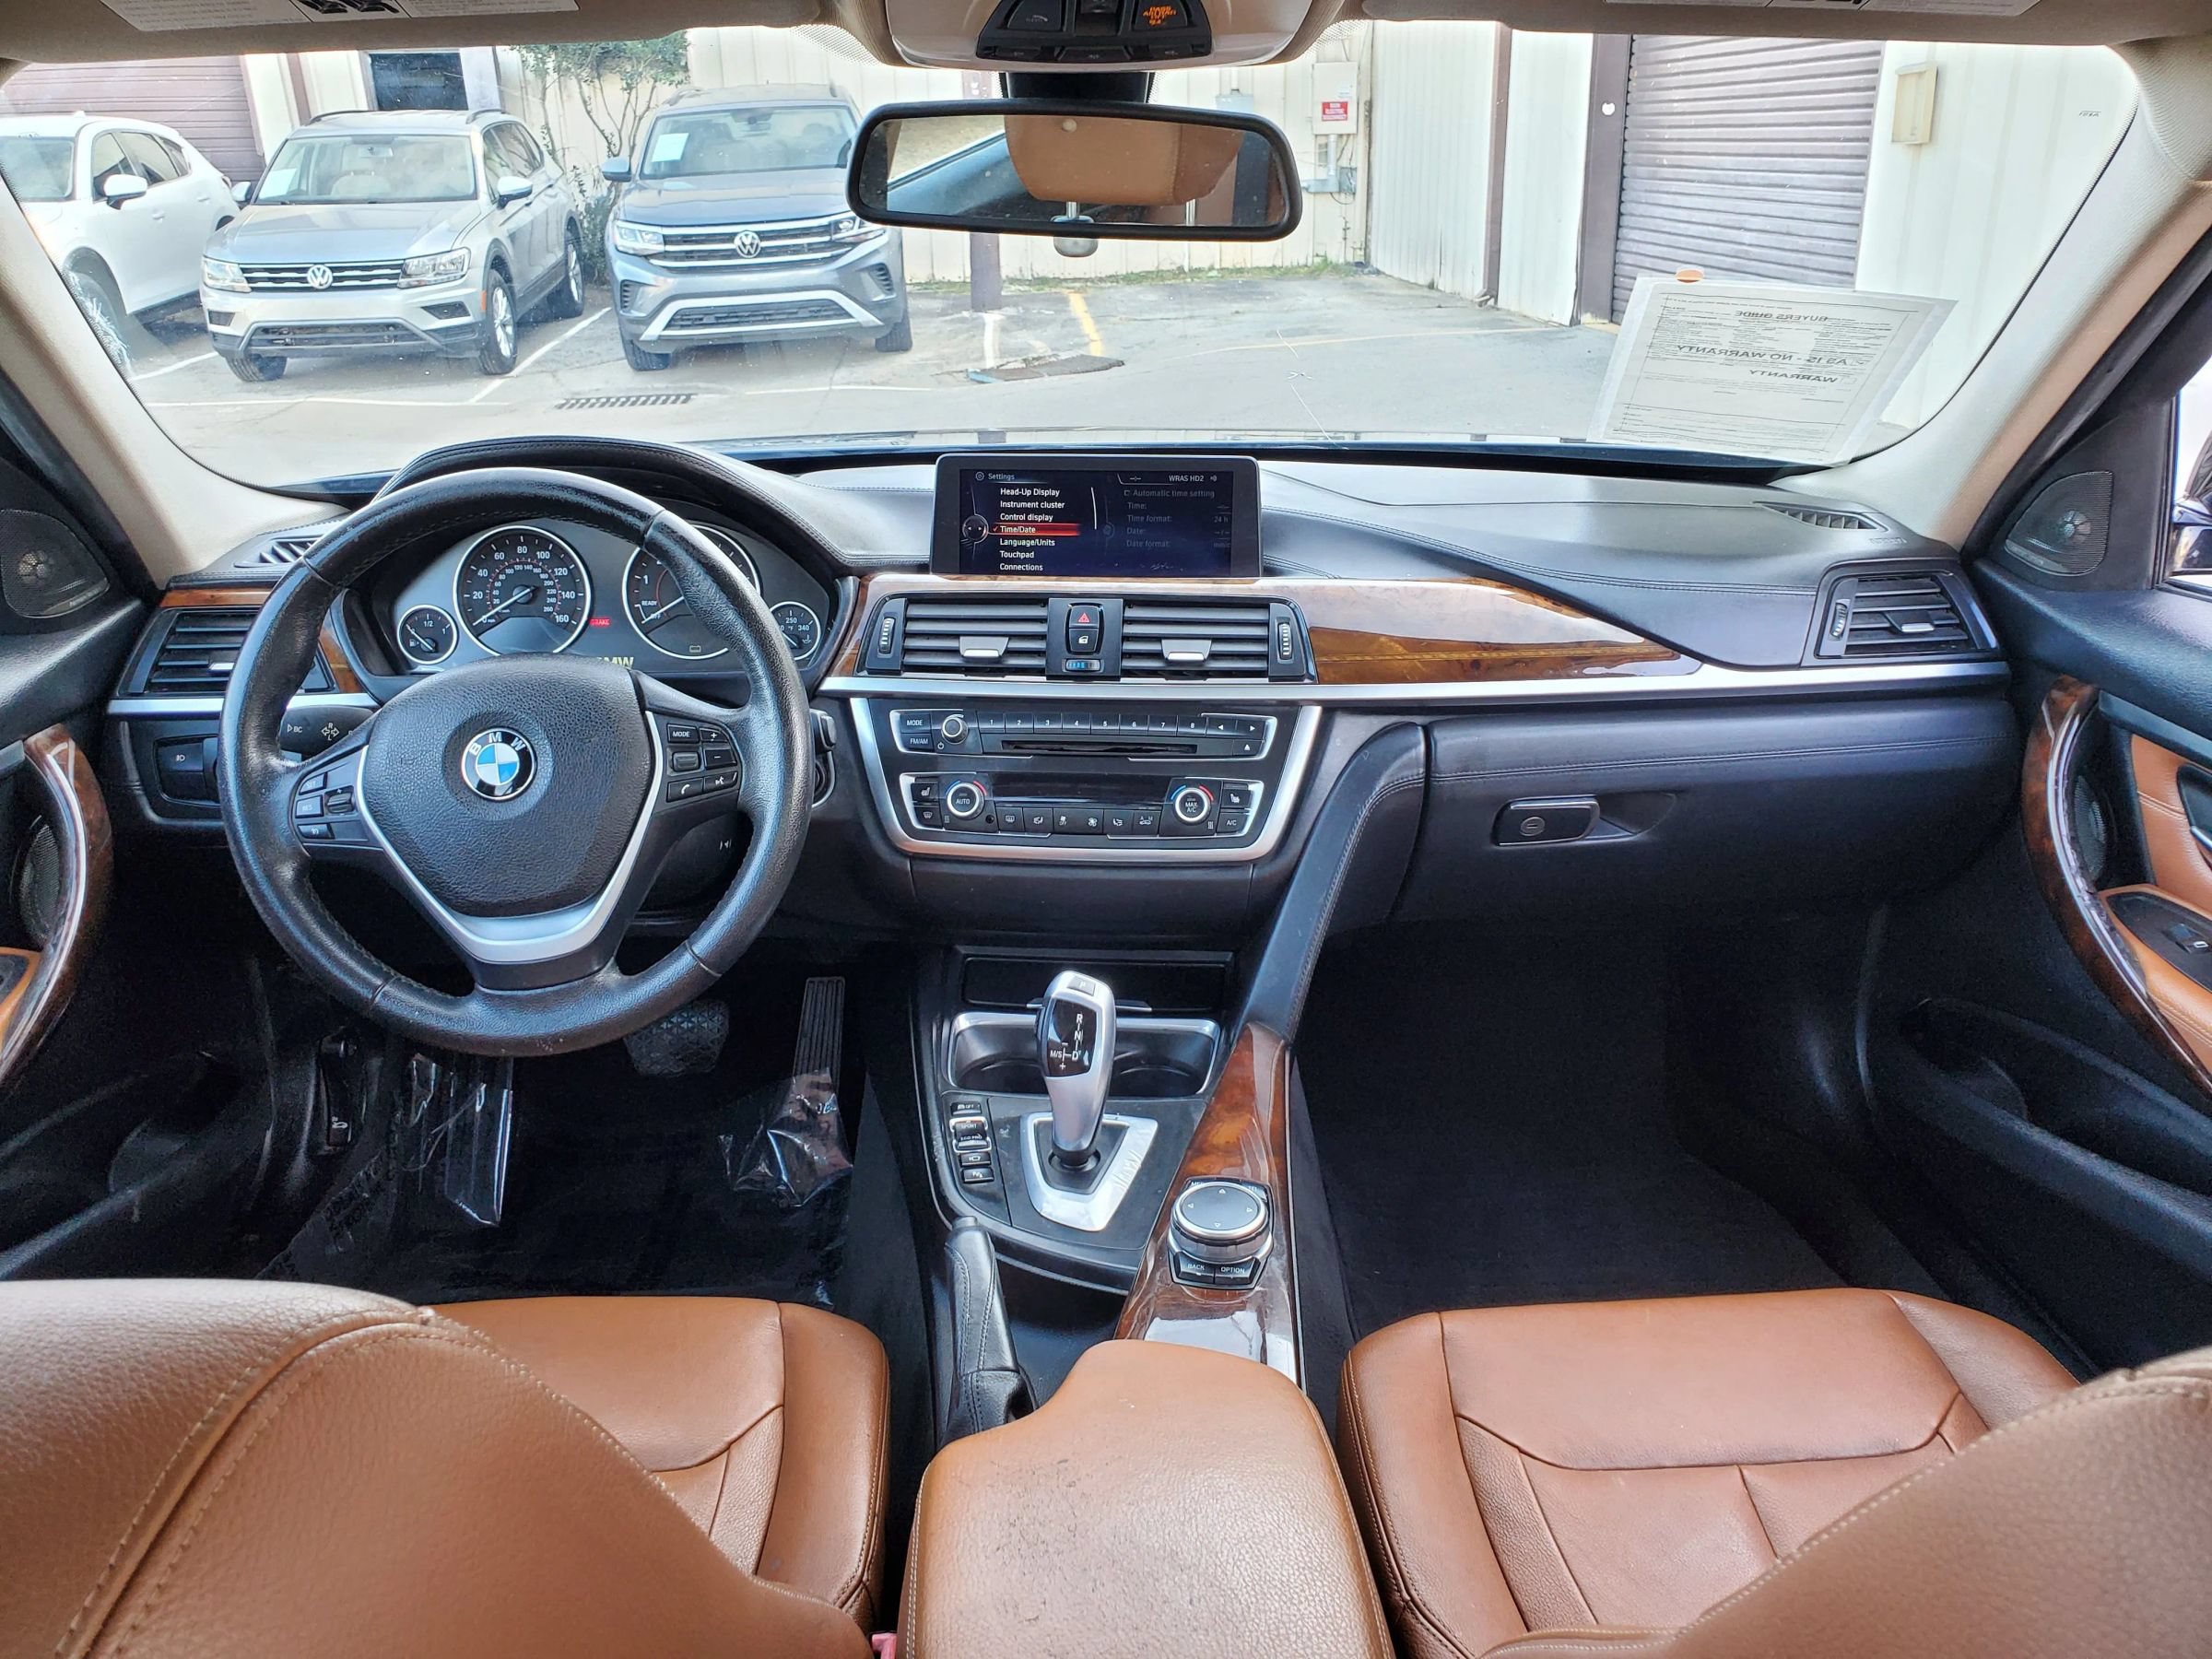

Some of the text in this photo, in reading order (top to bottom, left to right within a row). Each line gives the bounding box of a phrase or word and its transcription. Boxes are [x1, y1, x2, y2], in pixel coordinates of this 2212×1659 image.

[987, 473, 1015, 481] Settings
[1000, 488, 1060, 497] Head-Up Display
[1190, 490, 1215, 499] setting
[1000, 500, 1065, 509] Instrument cluster
[1127, 501, 1147, 510] Time:
[1027, 513, 1053, 523] display
[1127, 514, 1145, 523] Time
[1000, 525, 1036, 534] Time/Date
[999, 538, 1055, 547] Language/Units
[517, 546, 528, 554] 80
[999, 550, 1034, 559] Touchpad
[494, 552, 505, 560] 60
[535, 551, 550, 559] 100
[477, 569, 488, 577] 40
[554, 568, 568, 576] 120
[473, 591, 483, 599] 20
[561, 591, 575, 599] 140
[555, 615, 569, 623] 160
[596, 656, 634, 669] MW
[468, 731, 526, 756] BMW
[1077, 1013, 1083, 1024] R
[1074, 1031, 1081, 1041] N
[1050, 1050, 1063, 1058] M/S
